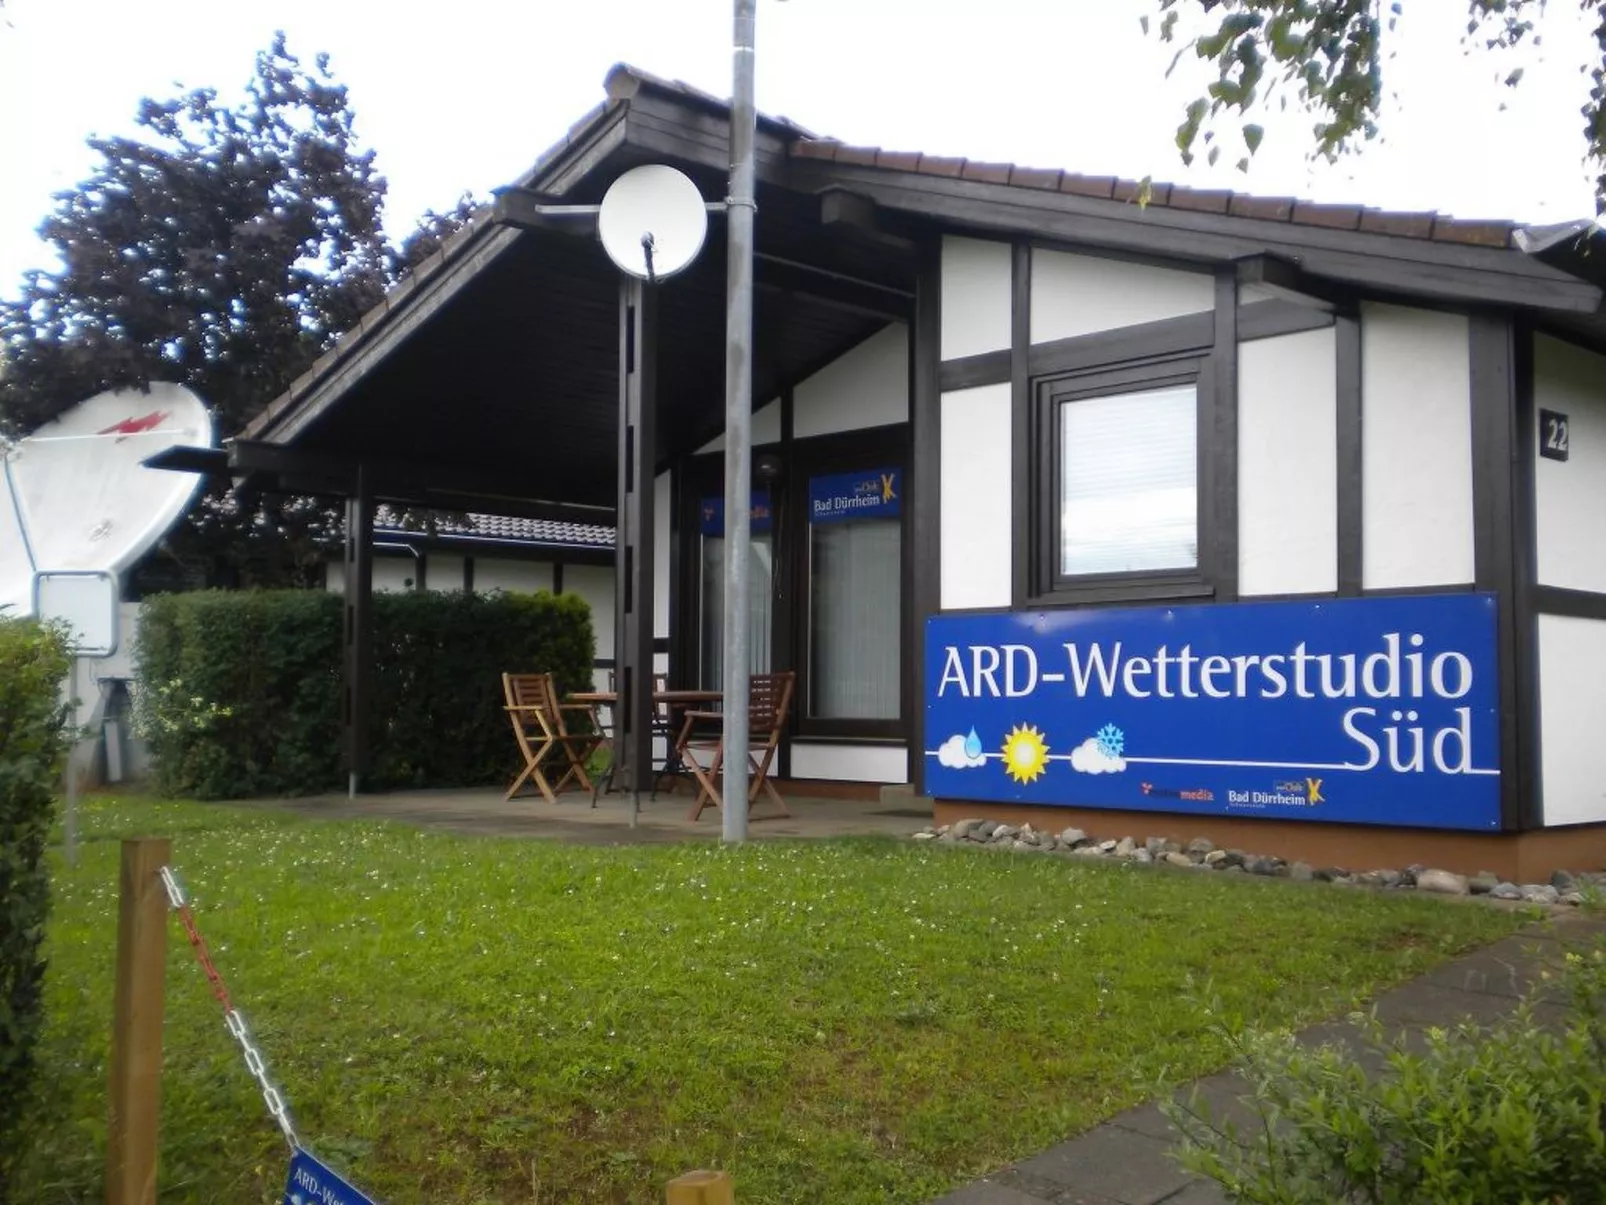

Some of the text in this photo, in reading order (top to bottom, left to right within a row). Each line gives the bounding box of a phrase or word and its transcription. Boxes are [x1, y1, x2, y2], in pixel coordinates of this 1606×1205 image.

[1547, 418, 1568, 451] 22
[814, 493, 880, 512] Bad Dürrheim
[936, 632, 1473, 699] ARD-Wetterstudio
[1343, 707, 1472, 775] Süd
[1228, 790, 1249, 803] Bad
[1253, 791, 1306, 806] Dürrheim
